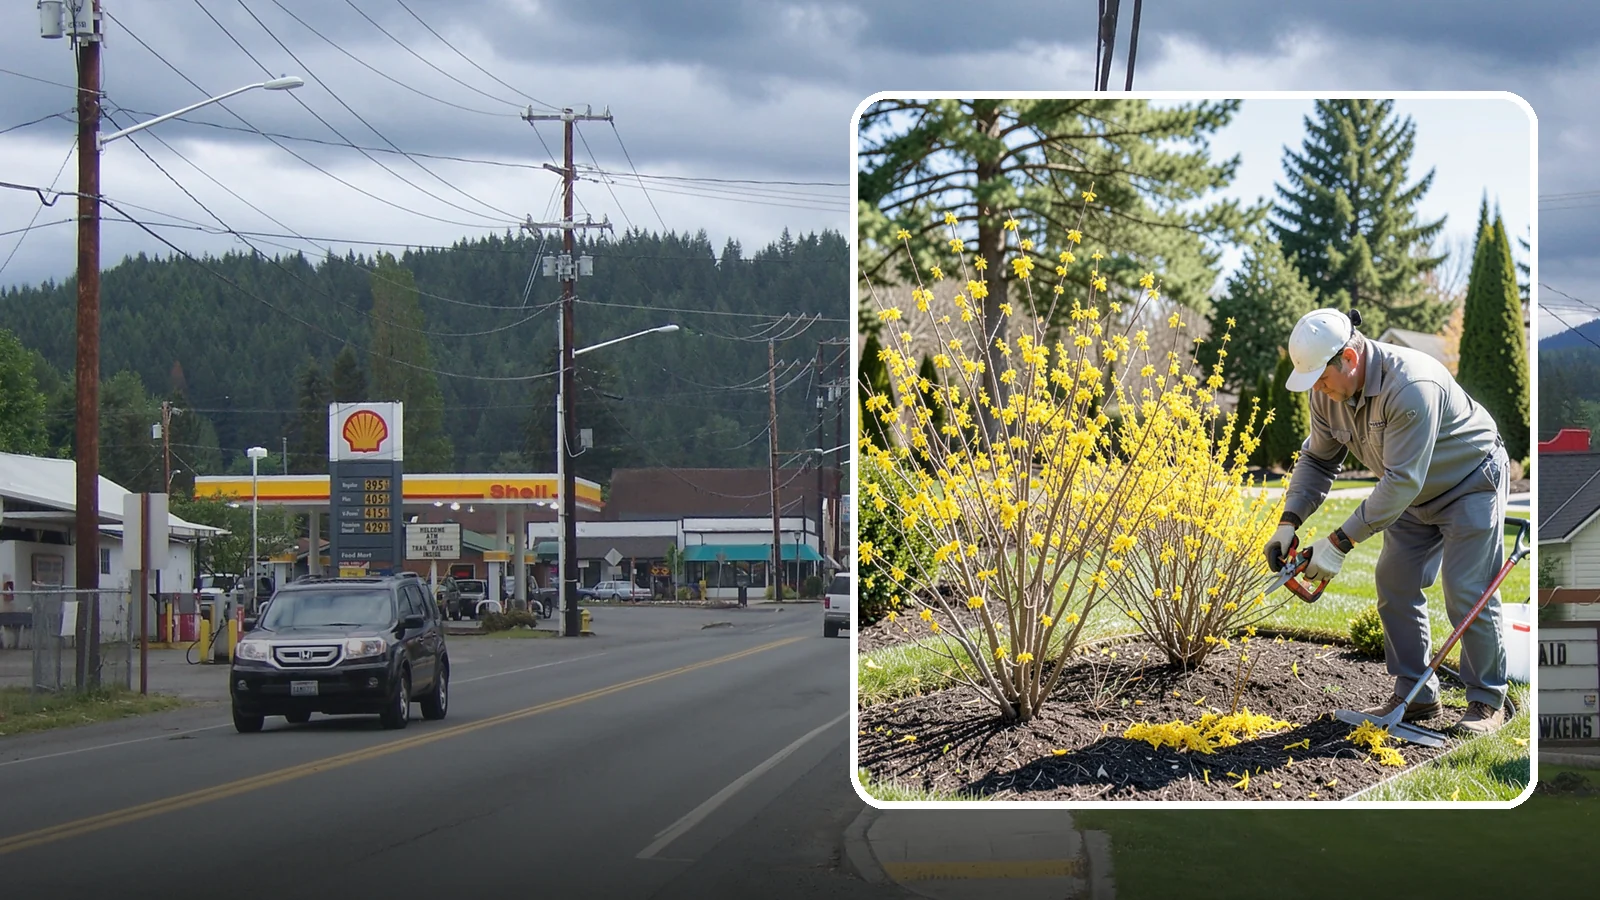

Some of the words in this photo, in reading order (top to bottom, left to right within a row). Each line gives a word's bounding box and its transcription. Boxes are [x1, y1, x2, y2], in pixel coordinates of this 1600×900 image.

[366, 480, 383, 490] 395
[490, 484, 547, 499] Shell
[366, 494, 383, 504] 405
[366, 508, 383, 518] 415
[366, 522, 383, 532] 429
